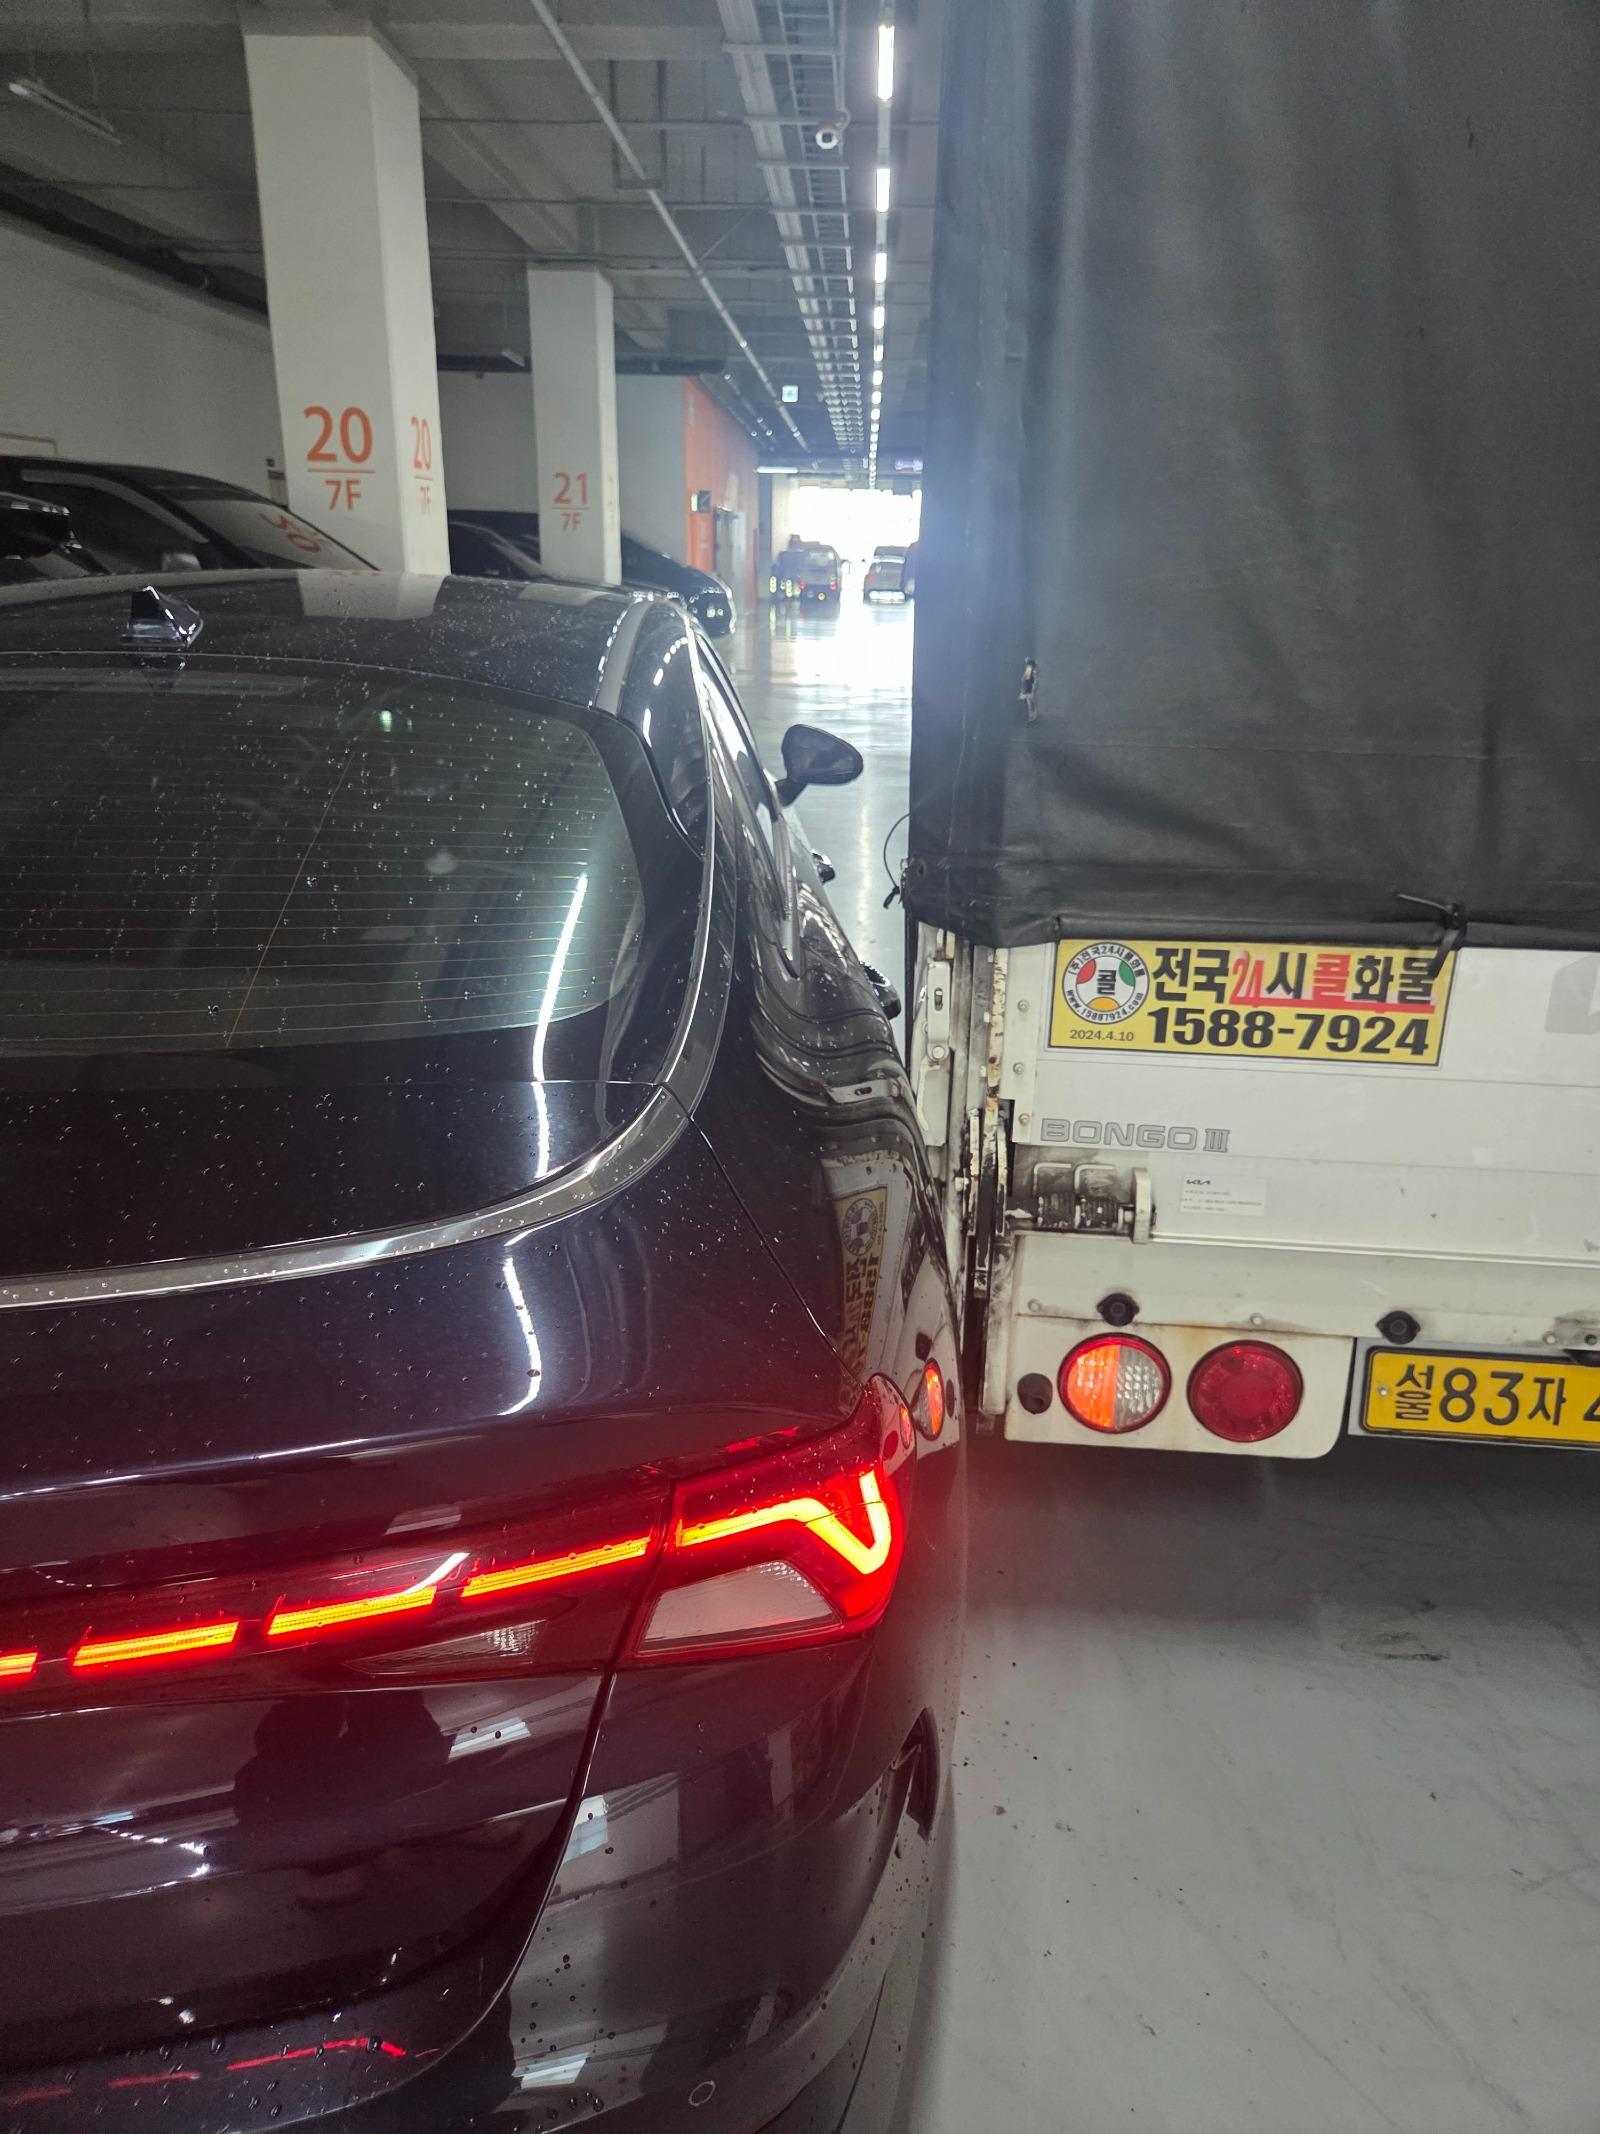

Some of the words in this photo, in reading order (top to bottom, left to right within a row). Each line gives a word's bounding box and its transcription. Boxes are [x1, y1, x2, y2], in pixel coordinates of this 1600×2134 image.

[304, 406, 373, 464] 20
[411, 416, 432, 470] 20
[325, 479, 361, 511] 7F
[554, 472, 588, 505] 21
[561, 512, 582, 531] 7F
[1097, 969, 1117, 995] 콜
[1070, 1029, 1134, 1041] 2024.4.10
[1147, 1008, 1429, 1056] 1588-7924
[1040, 1118, 1198, 1151] BONGO
